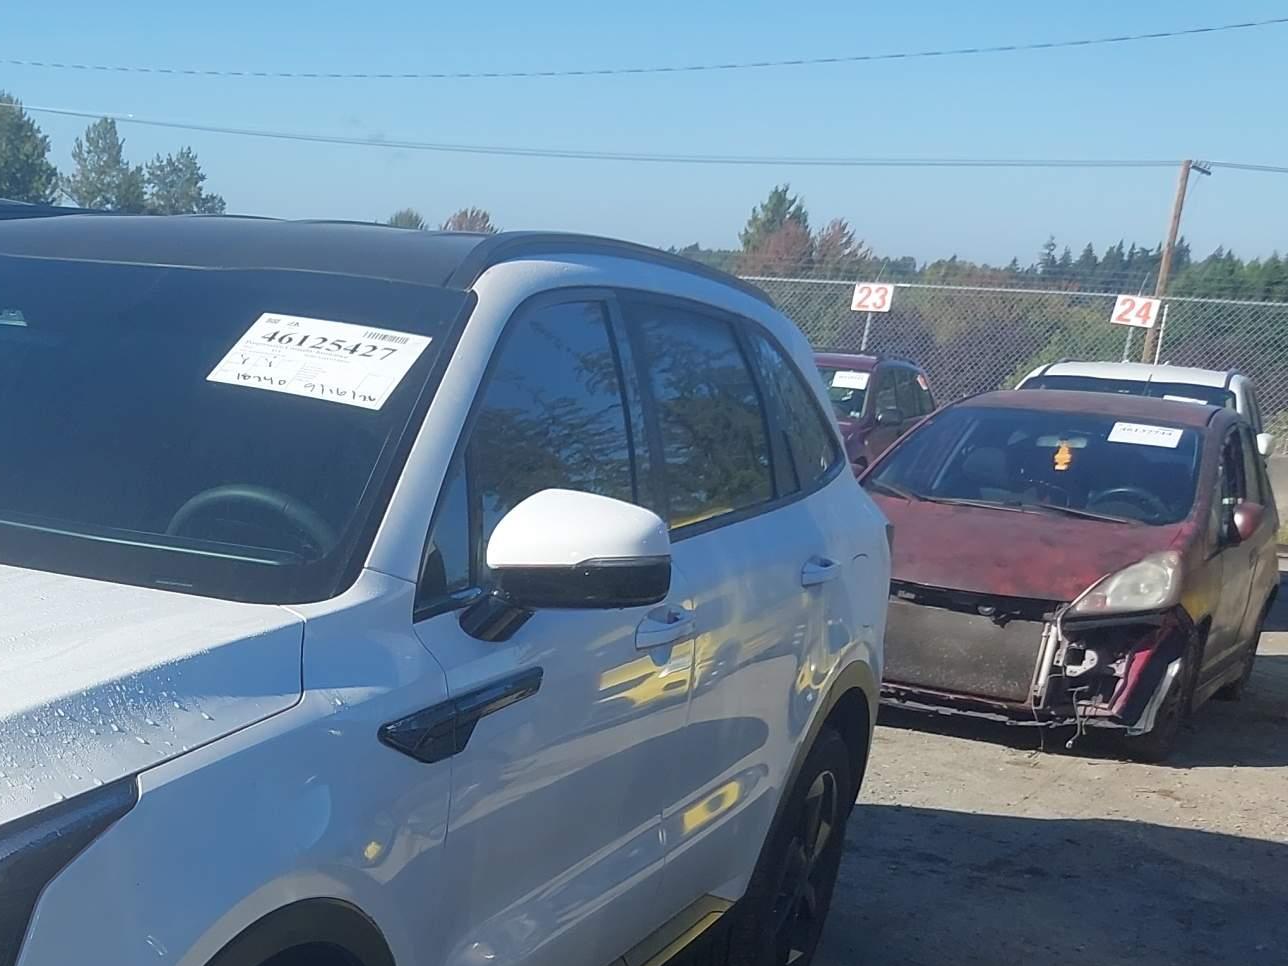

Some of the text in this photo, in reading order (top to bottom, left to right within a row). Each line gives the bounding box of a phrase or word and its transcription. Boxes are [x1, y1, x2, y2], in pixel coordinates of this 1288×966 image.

[855, 286, 889, 309] 23
[1115, 298, 1153, 325] 24
[260, 330, 398, 361] 46125427
